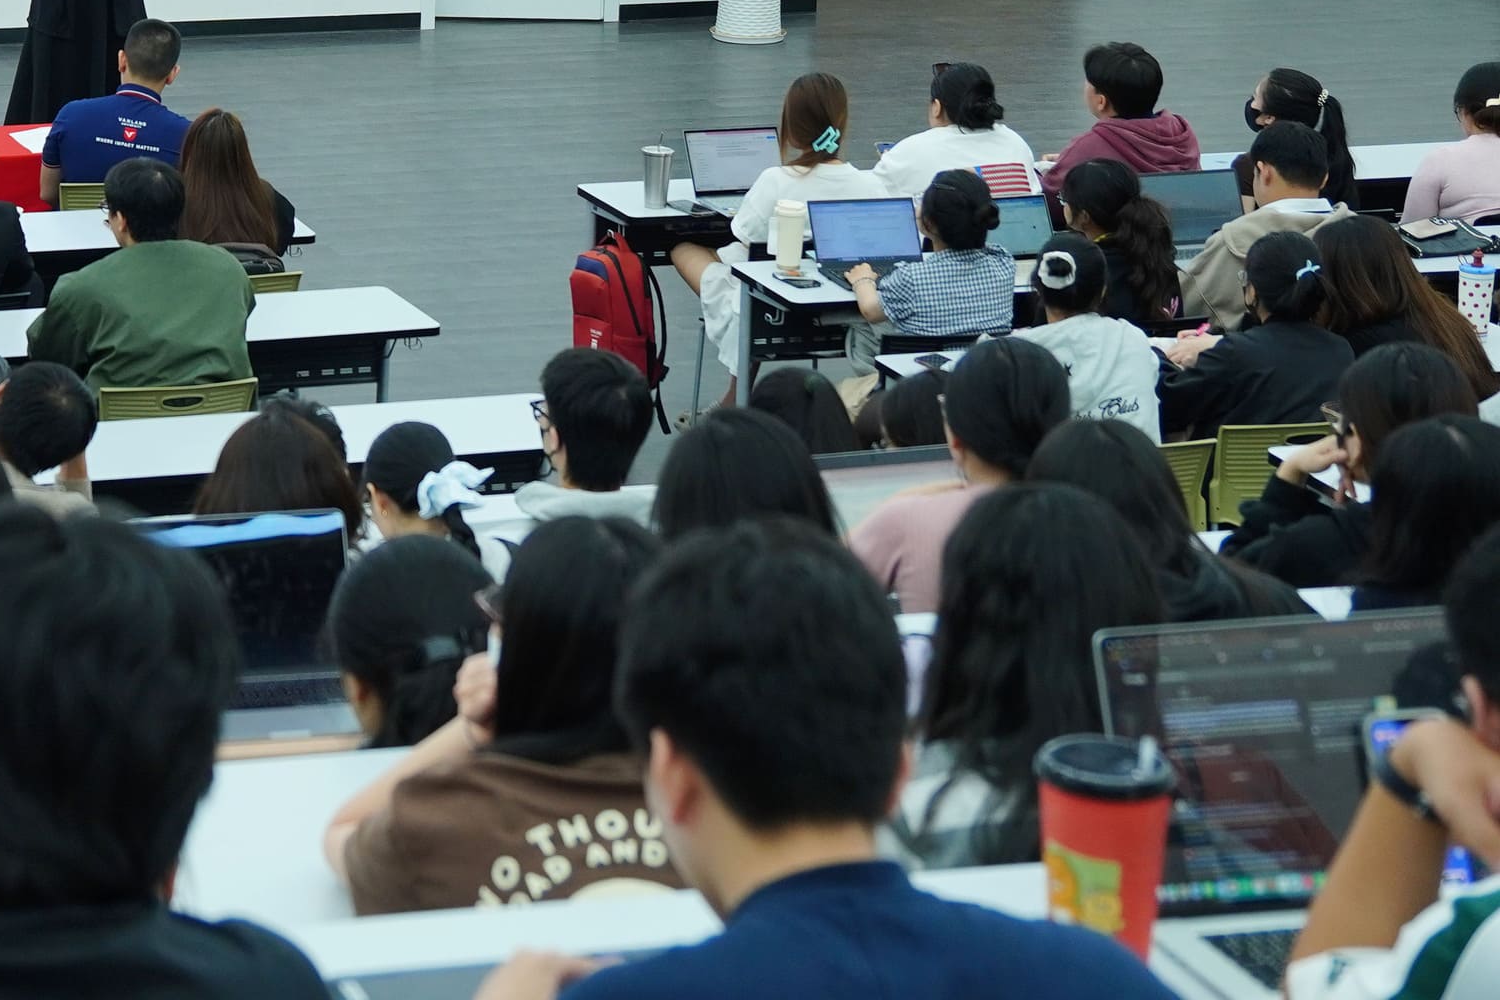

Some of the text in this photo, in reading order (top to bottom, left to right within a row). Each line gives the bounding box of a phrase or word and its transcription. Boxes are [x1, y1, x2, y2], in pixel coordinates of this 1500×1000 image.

[115, 140, 134, 148] IMPACT
[136, 144, 160, 152] MATTERS
[585, 837, 670, 870] AND
